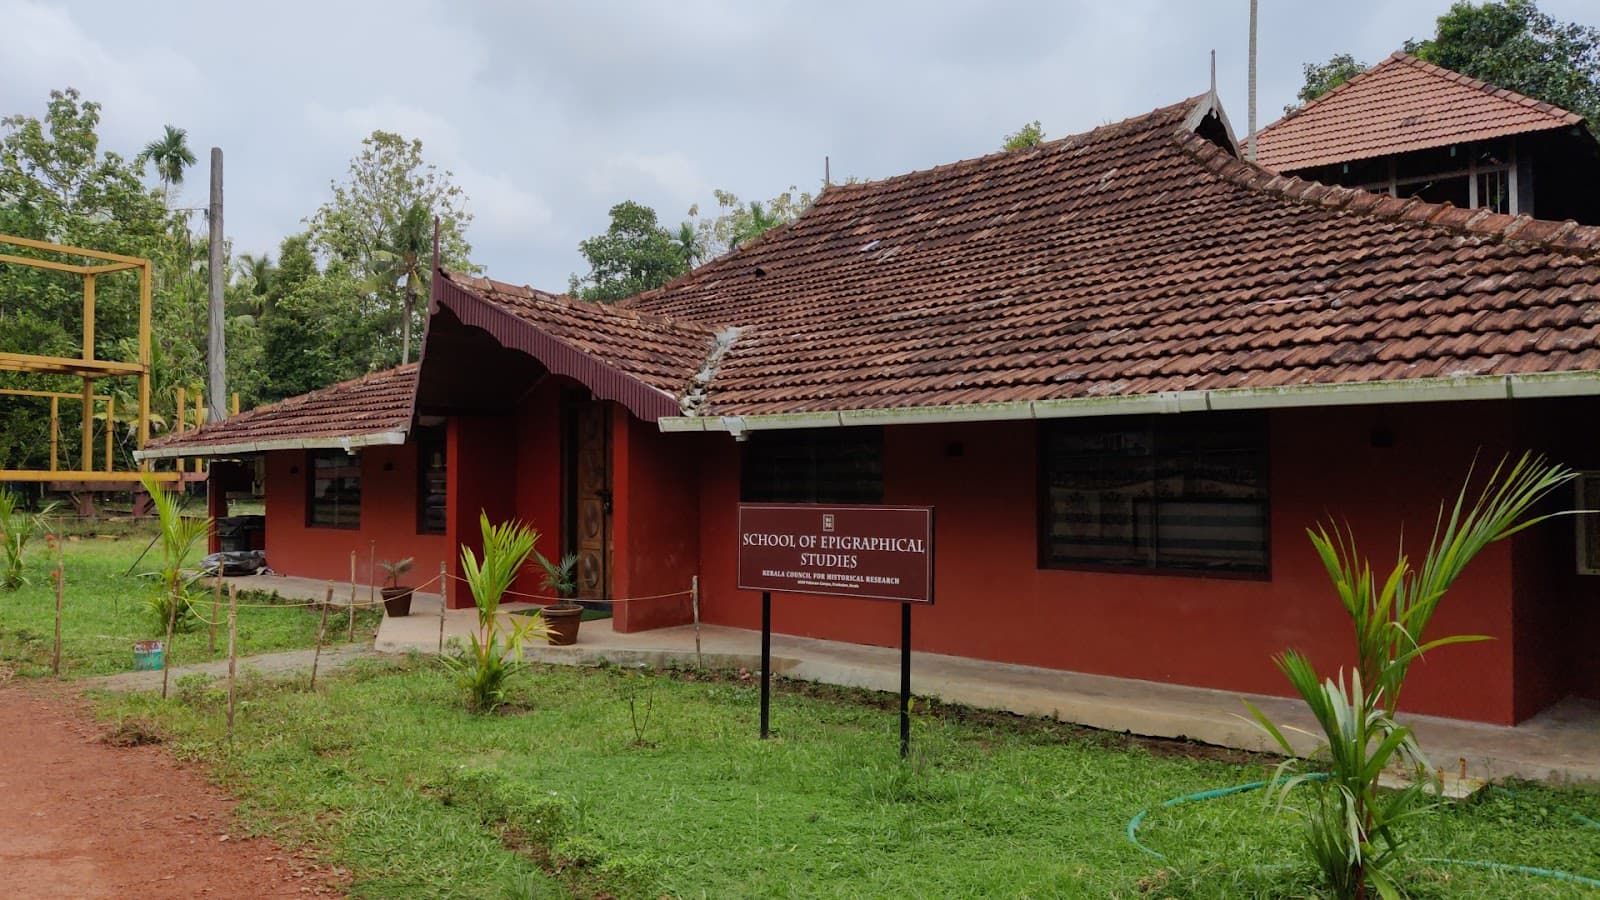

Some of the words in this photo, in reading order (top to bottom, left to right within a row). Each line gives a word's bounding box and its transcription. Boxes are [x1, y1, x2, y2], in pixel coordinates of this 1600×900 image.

[743, 533, 796, 548] SCHOOL
[799, 535, 817, 549] OF
[821, 536, 925, 553] EPIGRAPHICAL
[801, 553, 858, 569] STUDIES
[787, 571, 811, 579] COUNCIL
[827, 574, 865, 583] HISTORICAL
[866, 576, 900, 585] RESEARCH
